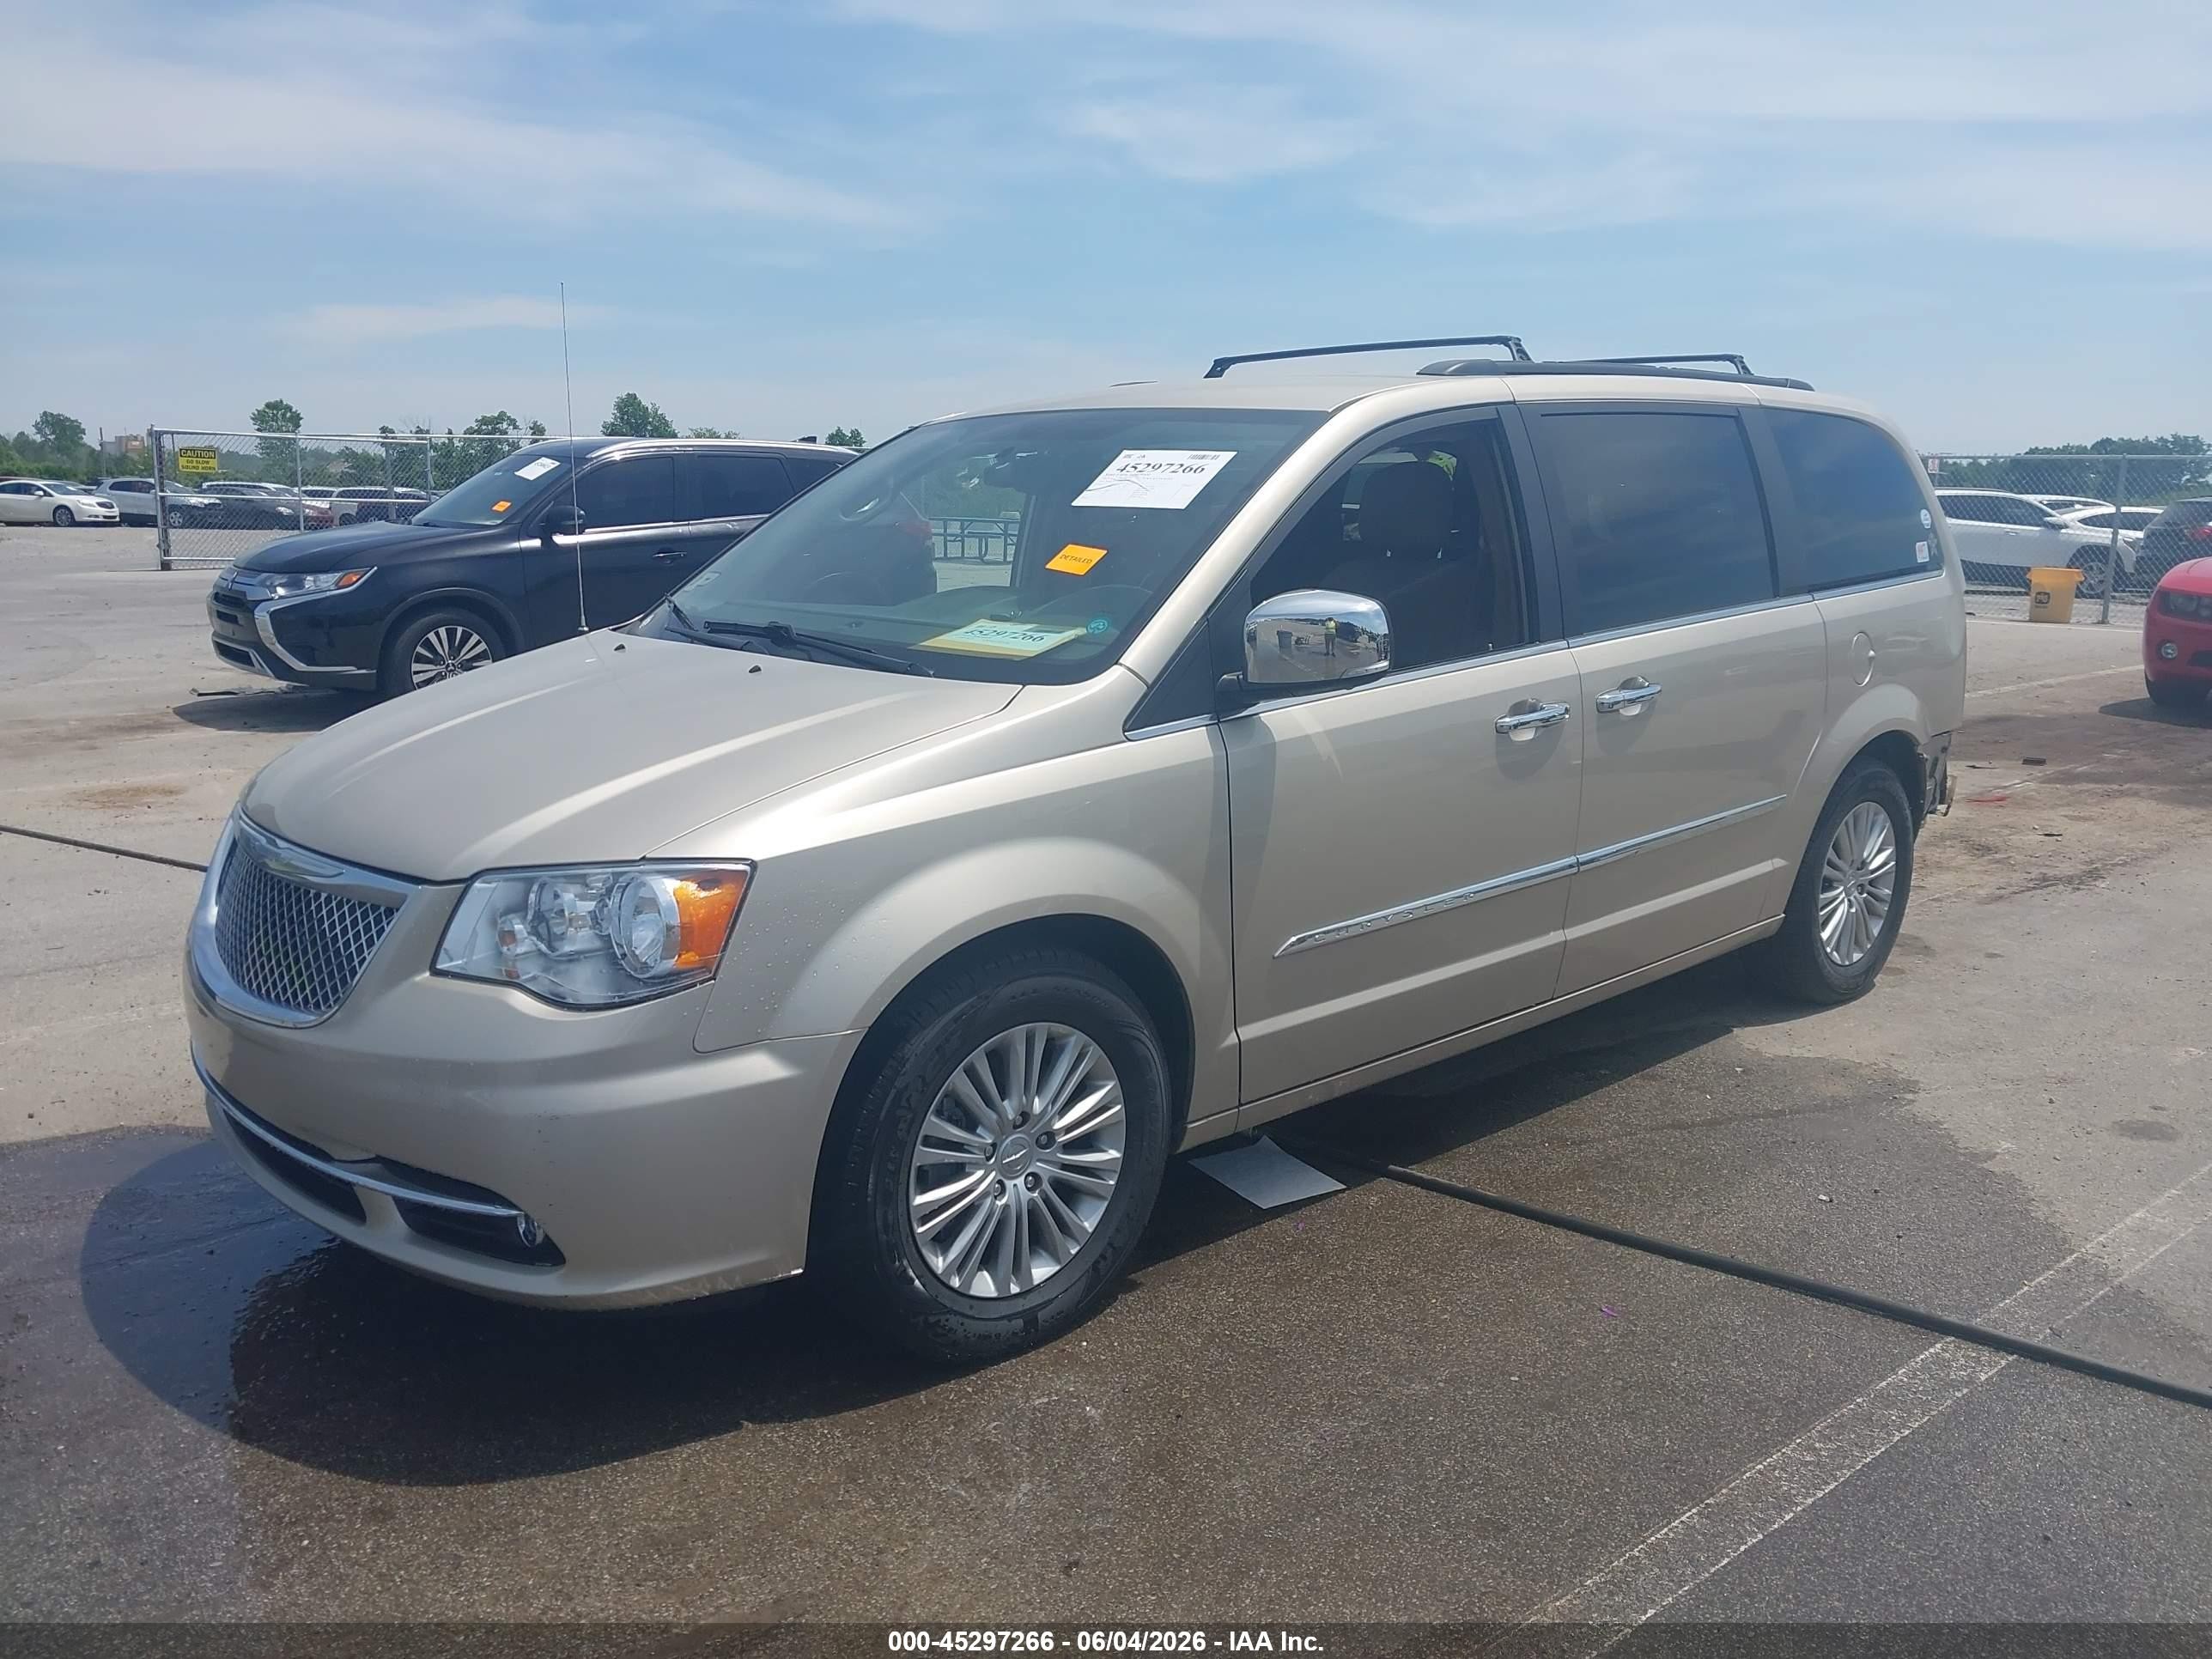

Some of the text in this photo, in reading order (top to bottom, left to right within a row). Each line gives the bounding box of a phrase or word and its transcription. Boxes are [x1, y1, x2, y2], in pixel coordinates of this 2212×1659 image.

[1116, 462, 1210, 473] 45297266
[1059, 554, 1093, 564] DETAILED
[965, 628, 1045, 642] 45297266
[1314, 892, 1474, 943] CHRYSLER
